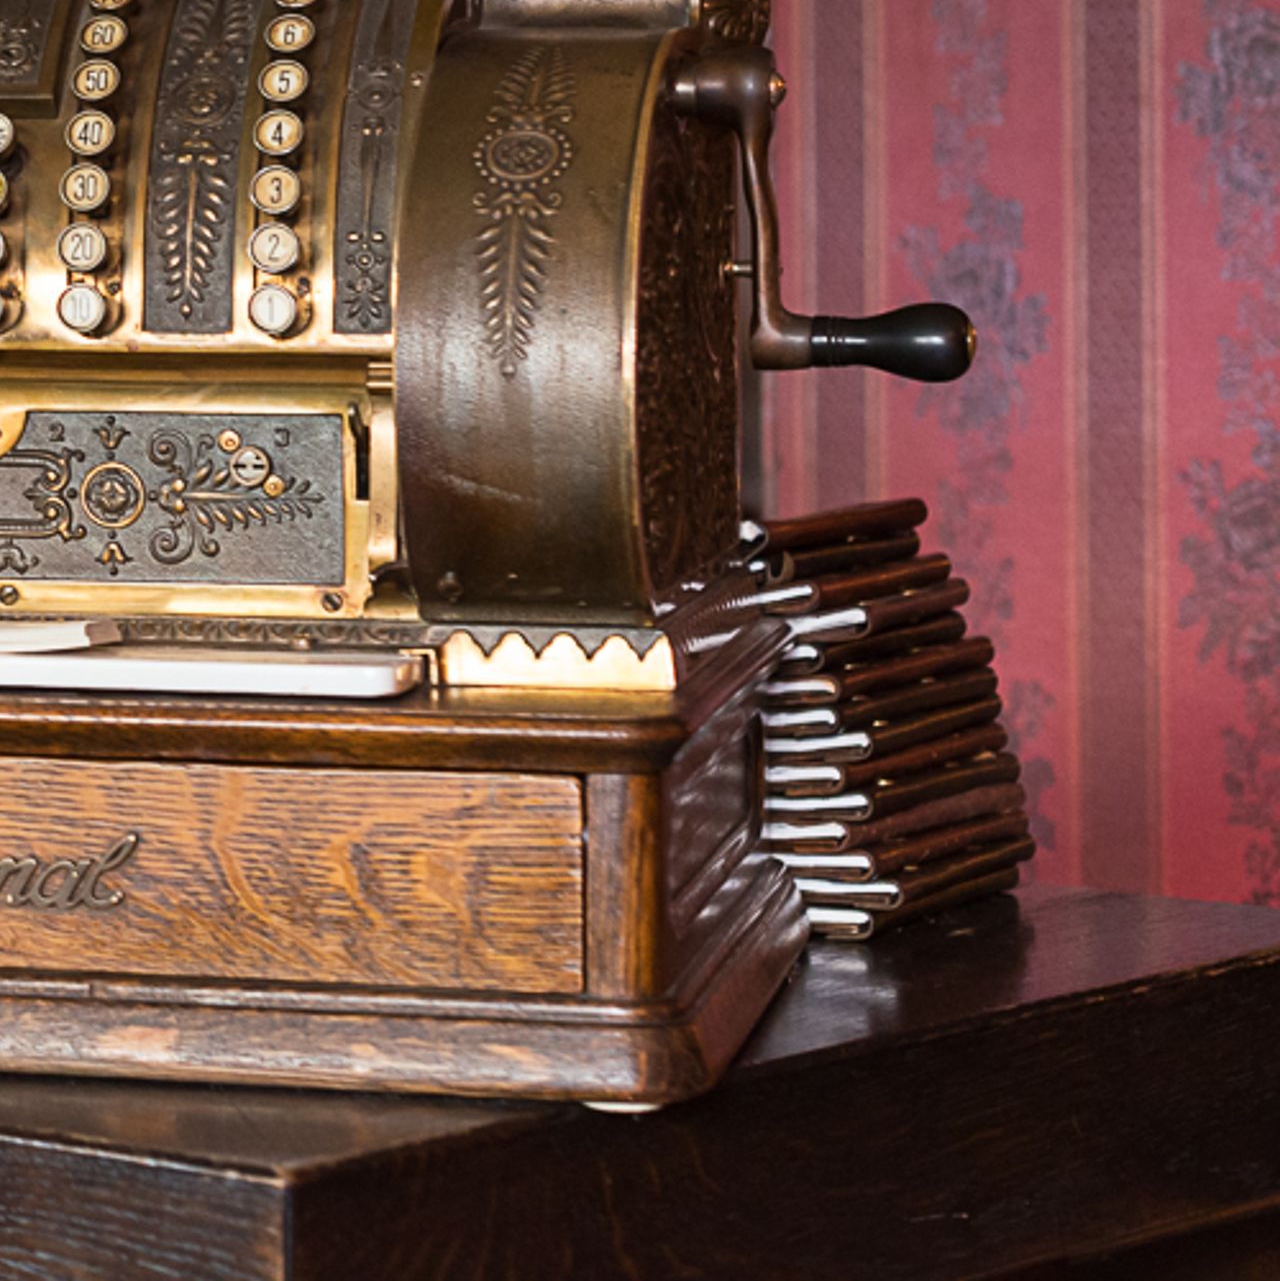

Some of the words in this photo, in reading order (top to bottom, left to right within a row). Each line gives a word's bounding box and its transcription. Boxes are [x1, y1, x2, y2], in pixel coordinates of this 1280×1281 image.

[91, 23, 116, 46] 60
[283, 23, 296, 45] 6
[85, 69, 109, 92] 50
[277, 69, 291, 94] 5
[77, 120, 103, 146] 40
[271, 120, 285, 146] 4
[73, 174, 98, 201] 30
[270, 176, 283, 205] 3
[70, 232, 94, 261] 20
[266, 232, 282, 262] 2
[69, 291, 90, 319] 10
[266, 294, 277, 321] 1
